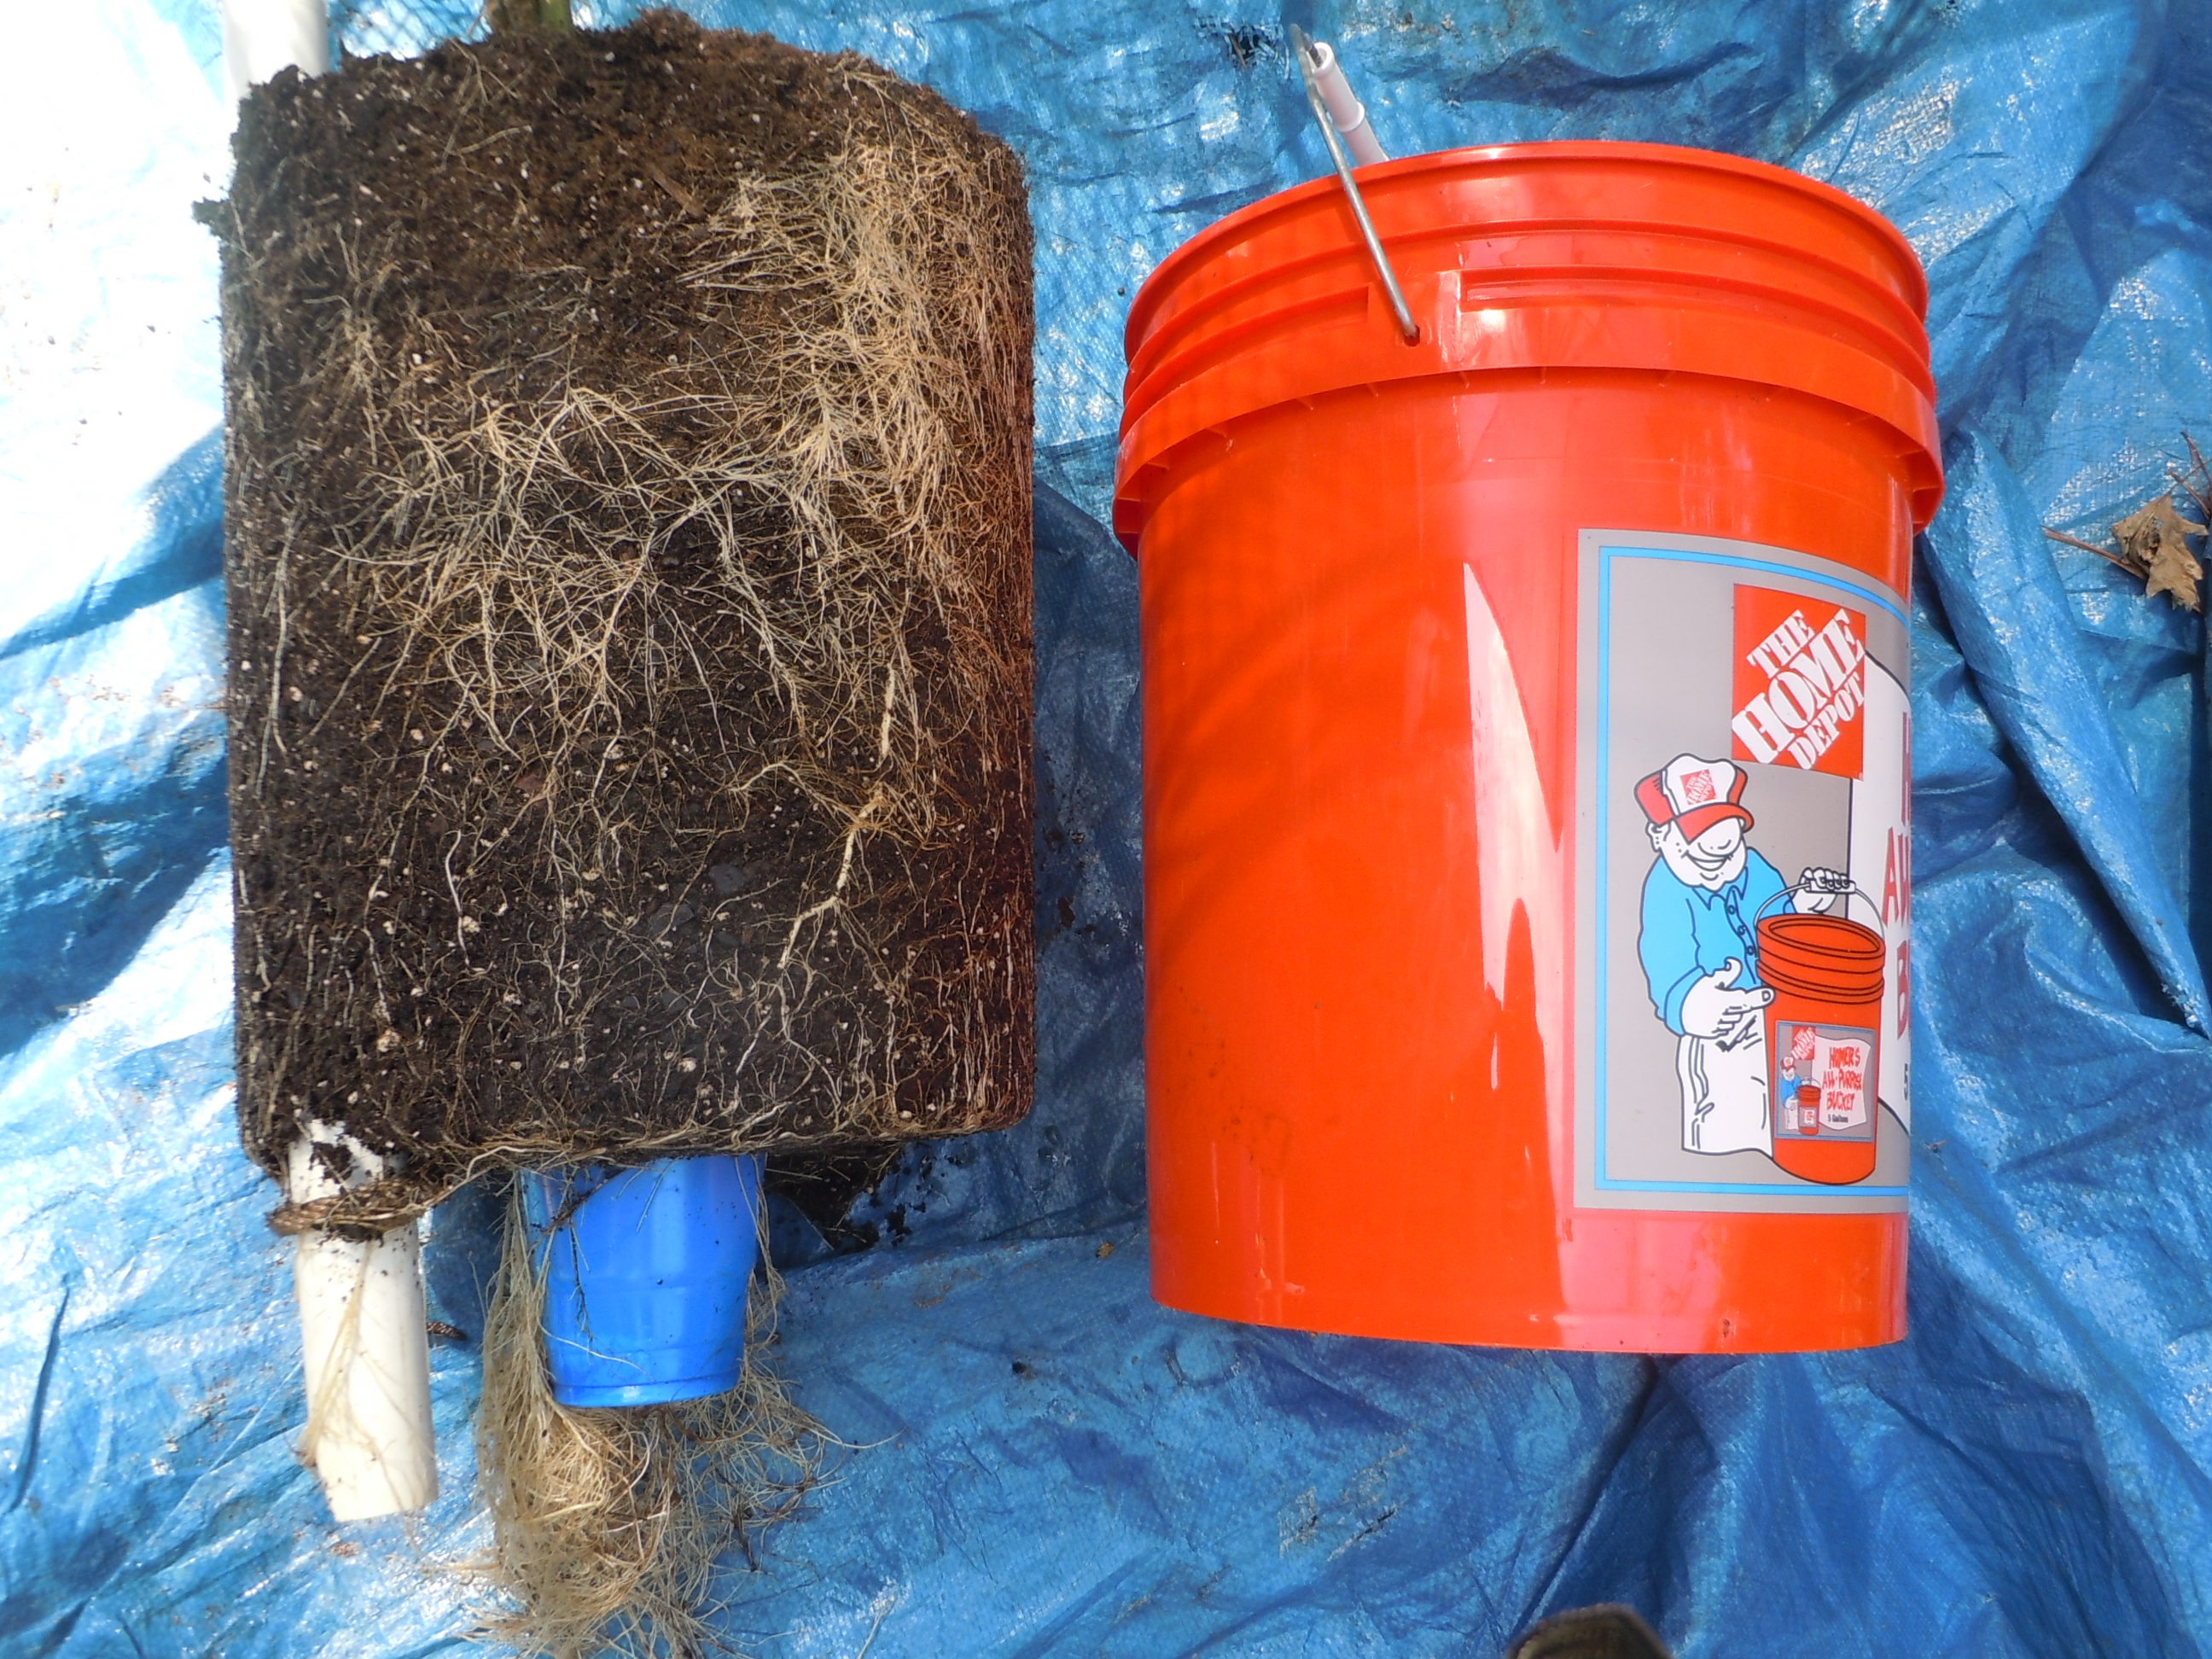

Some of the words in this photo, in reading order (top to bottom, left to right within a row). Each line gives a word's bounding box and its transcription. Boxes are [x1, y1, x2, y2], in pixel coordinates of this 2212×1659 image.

[1732, 608, 1865, 764] HOME
[1746, 609, 1815, 678] THE
[1787, 671, 1864, 770] DEPOT
